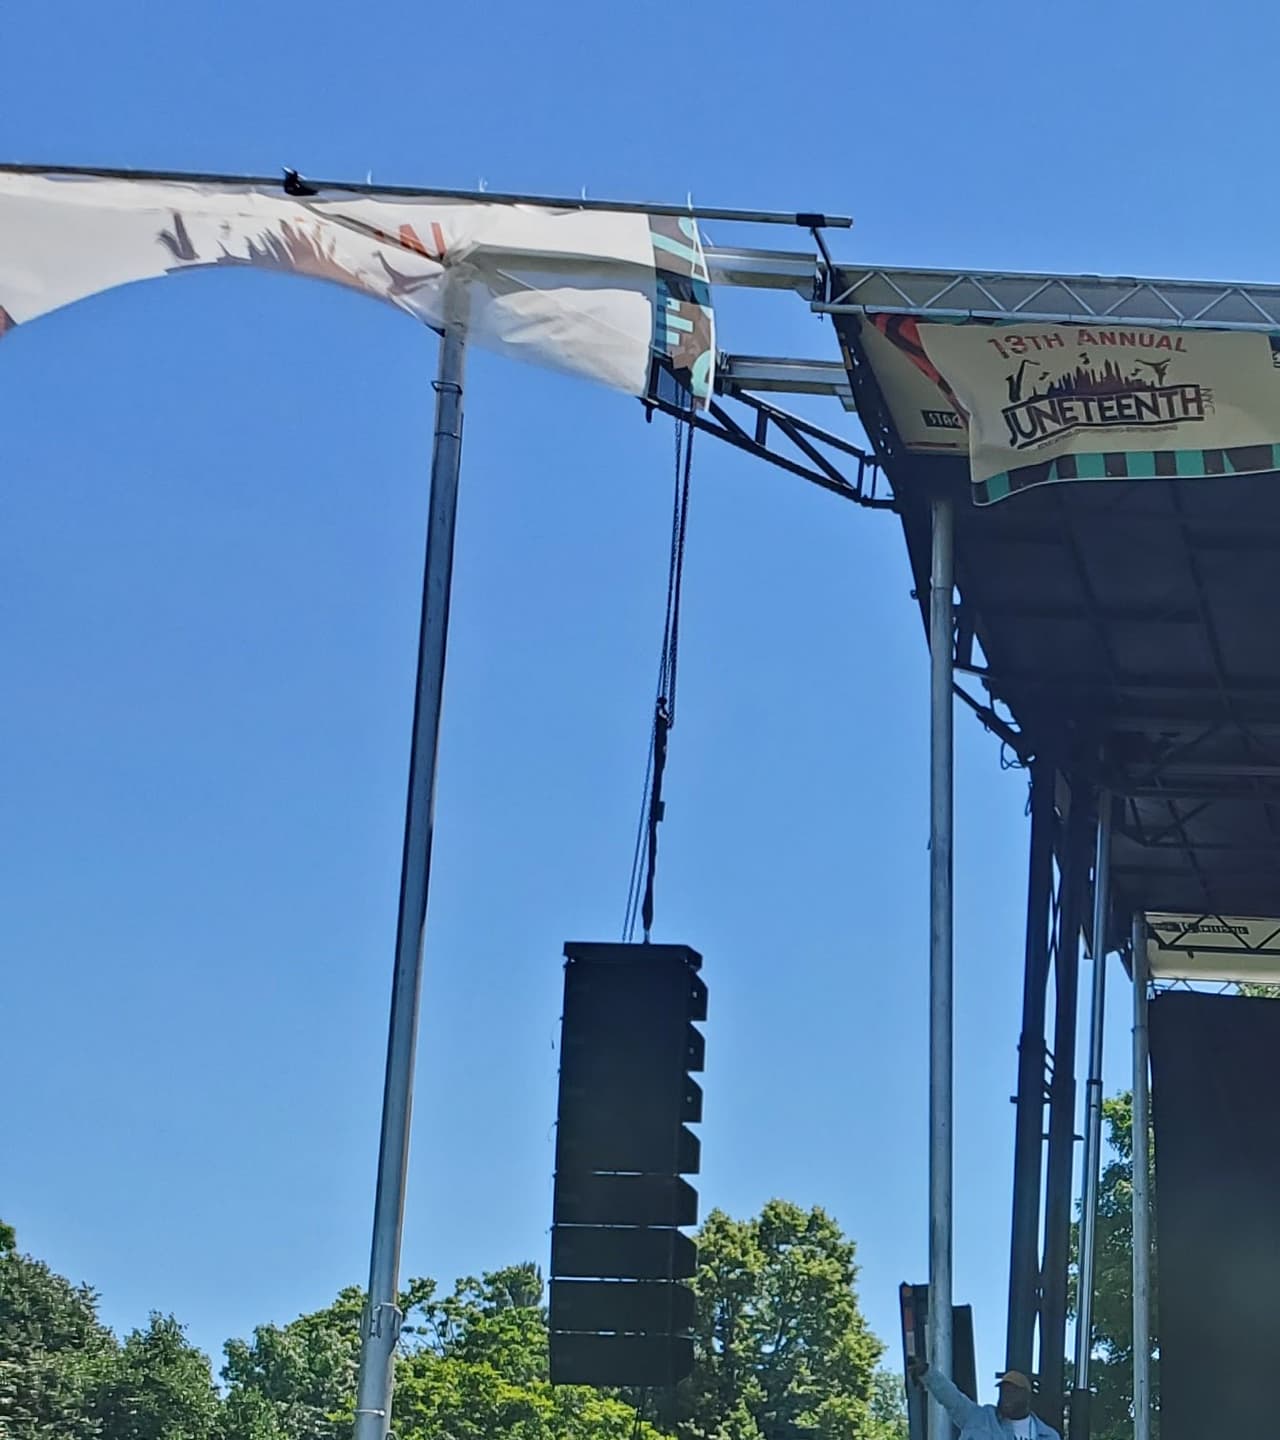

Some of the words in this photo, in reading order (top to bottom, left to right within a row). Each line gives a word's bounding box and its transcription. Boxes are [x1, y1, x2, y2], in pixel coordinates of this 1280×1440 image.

[987, 333, 1064, 358] 13TH
[1077, 329, 1187, 352] ANNUAL
[1003, 388, 1204, 447] JUNETEENTH
